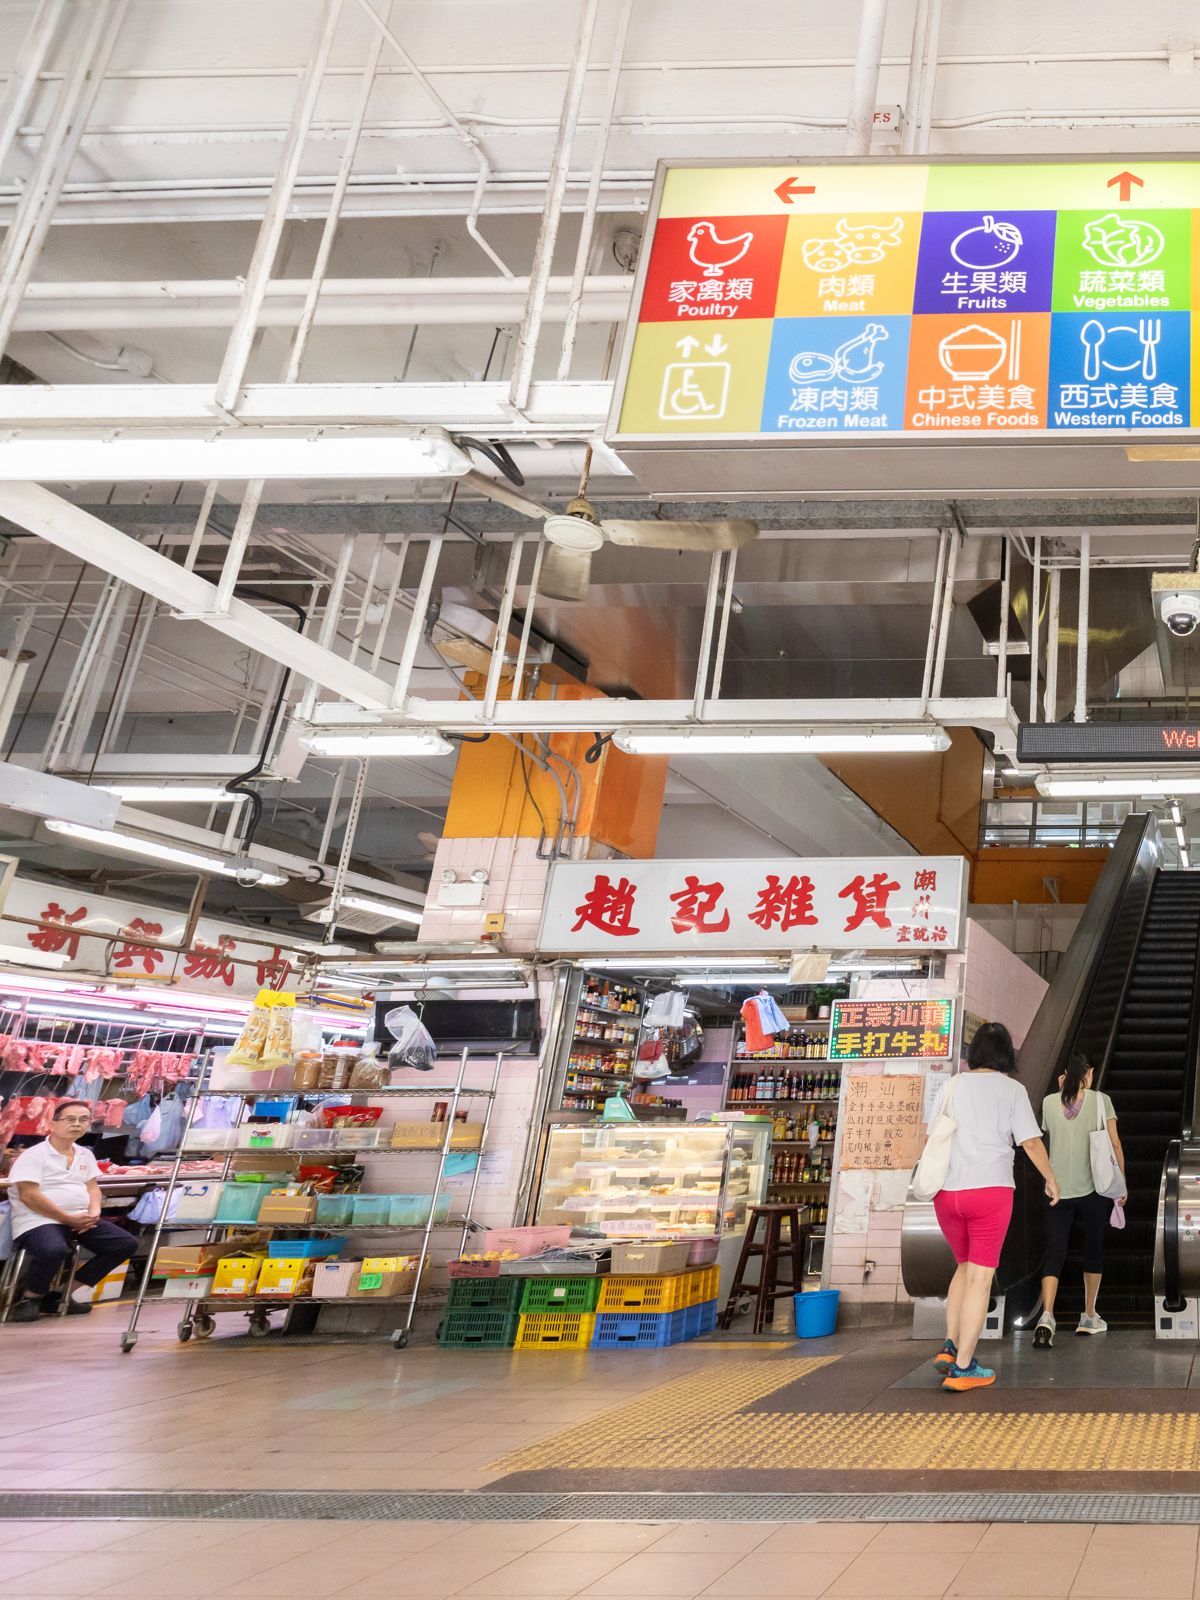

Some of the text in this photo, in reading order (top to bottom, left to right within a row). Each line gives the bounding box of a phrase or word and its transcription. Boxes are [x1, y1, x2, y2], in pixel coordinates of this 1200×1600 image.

[668, 278, 753, 303] 家禽類
[817, 274, 875, 297] 肉類
[941, 271, 1027, 295] 生果類
[1079, 269, 1165, 293] 蔬菜類
[678, 302, 738, 318] Poultry
[823, 299, 865, 312] Meat
[957, 296, 1007, 309] Fruits
[1073, 294, 1169, 309] Vegetables
[789, 386, 878, 412] 凍肉類
[918, 384, 1035, 411] 中式美食
[1060, 382, 1178, 409] 西式美食
[778, 413, 888, 429] Frozen Meat
[912, 411, 1038, 427] Chinese Foods
[1054, 411, 1183, 426] Western Foods
[571, 872, 901, 937] 趙記雜貨
[838, 1005, 948, 1027] 正宗汕頭
[836, 1031, 946, 1054] 手打牛丸
